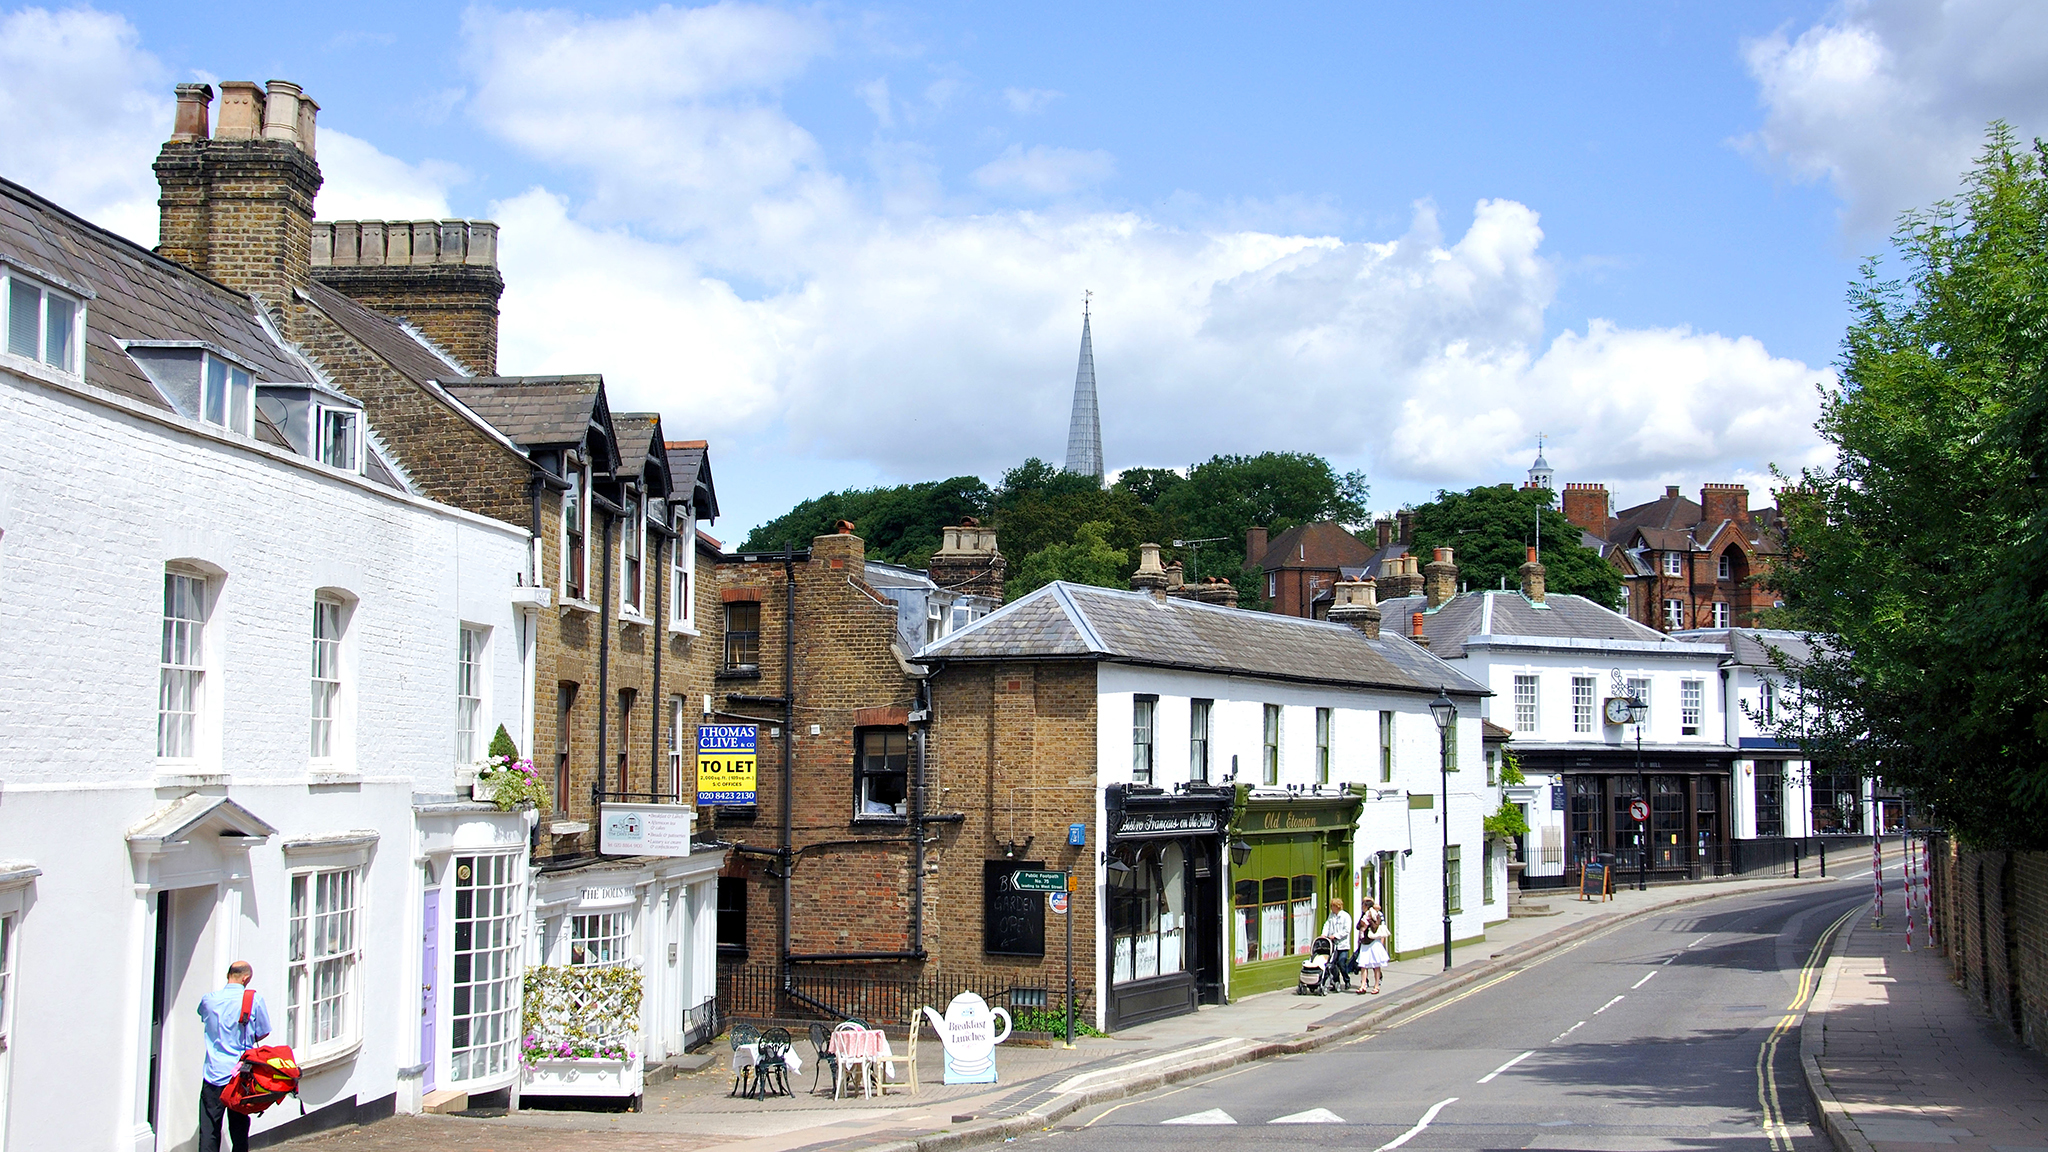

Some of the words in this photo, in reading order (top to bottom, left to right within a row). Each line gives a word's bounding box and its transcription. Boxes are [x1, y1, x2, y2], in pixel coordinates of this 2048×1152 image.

[700, 727, 754, 737] THOMAS
[700, 738, 738, 748] CLIVE
[701, 761, 721, 773] TO
[727, 761, 754, 772] LET
[1180, 820, 1188, 828] on
[1189, 813, 1197, 827] the
[1265, 811, 1280, 829] Old
[1286, 811, 1316, 828] Etonian
[581, 888, 599, 899] THE
[994, 895, 1036, 911] GARDEN
[1000, 916, 1033, 934] OPEN
[949, 1019, 986, 1031] Breakfast
[952, 1032, 986, 1043] Lunches
